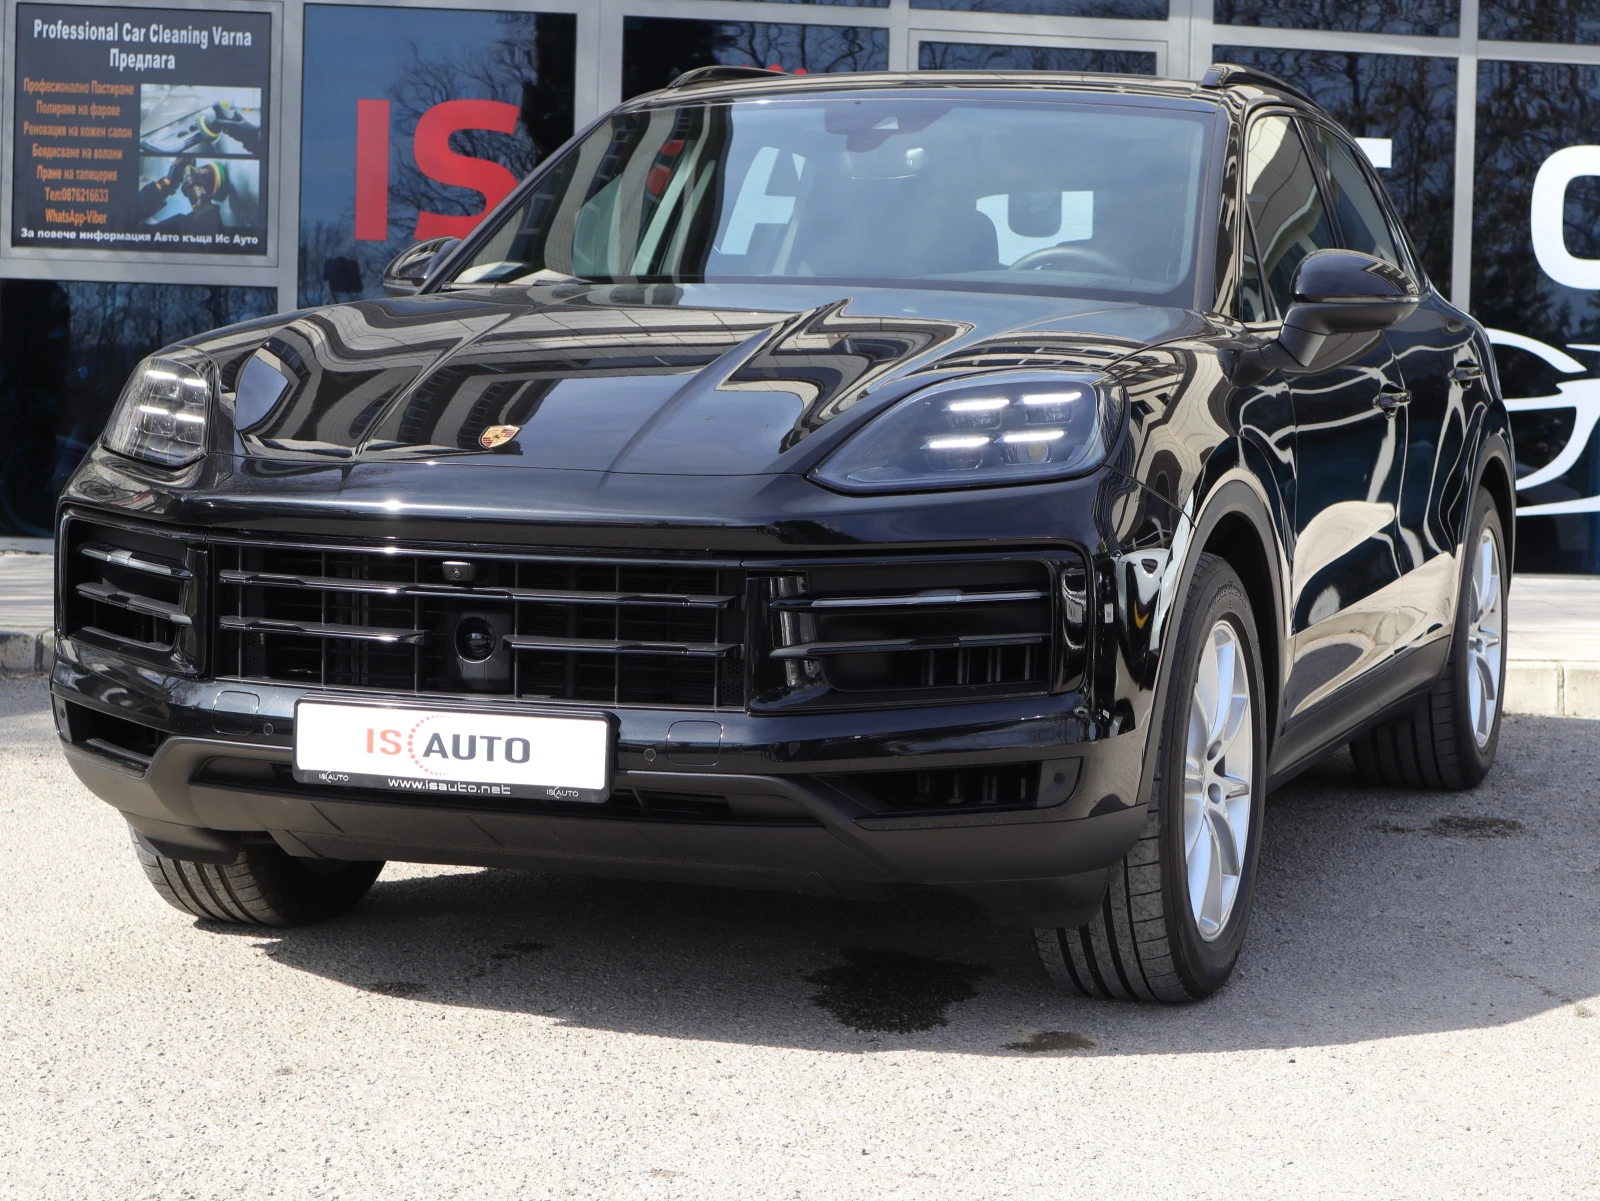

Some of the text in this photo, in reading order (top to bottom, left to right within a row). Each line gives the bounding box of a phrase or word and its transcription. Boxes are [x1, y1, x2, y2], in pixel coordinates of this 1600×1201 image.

[33, 19, 252, 49] Professional Car Cleaning Varna
[109, 48, 176, 72] Предлага
[23, 77, 90, 95] Професионално
[78, 104, 89, 115] на
[90, 102, 121, 119] фарове
[23, 121, 133, 138] Реновация на кожен салон
[81, 148, 92, 159] на
[36, 165, 62, 182] Пране
[63, 169, 74, 180] на
[45, 208, 107, 227] WhatsApp-Viber
[21, 228, 258, 246] За повече информация Авто къща Ис Ауто
[366, 728, 531, 764] IS AUTO
[387, 778, 511, 795] www.isauto.net
